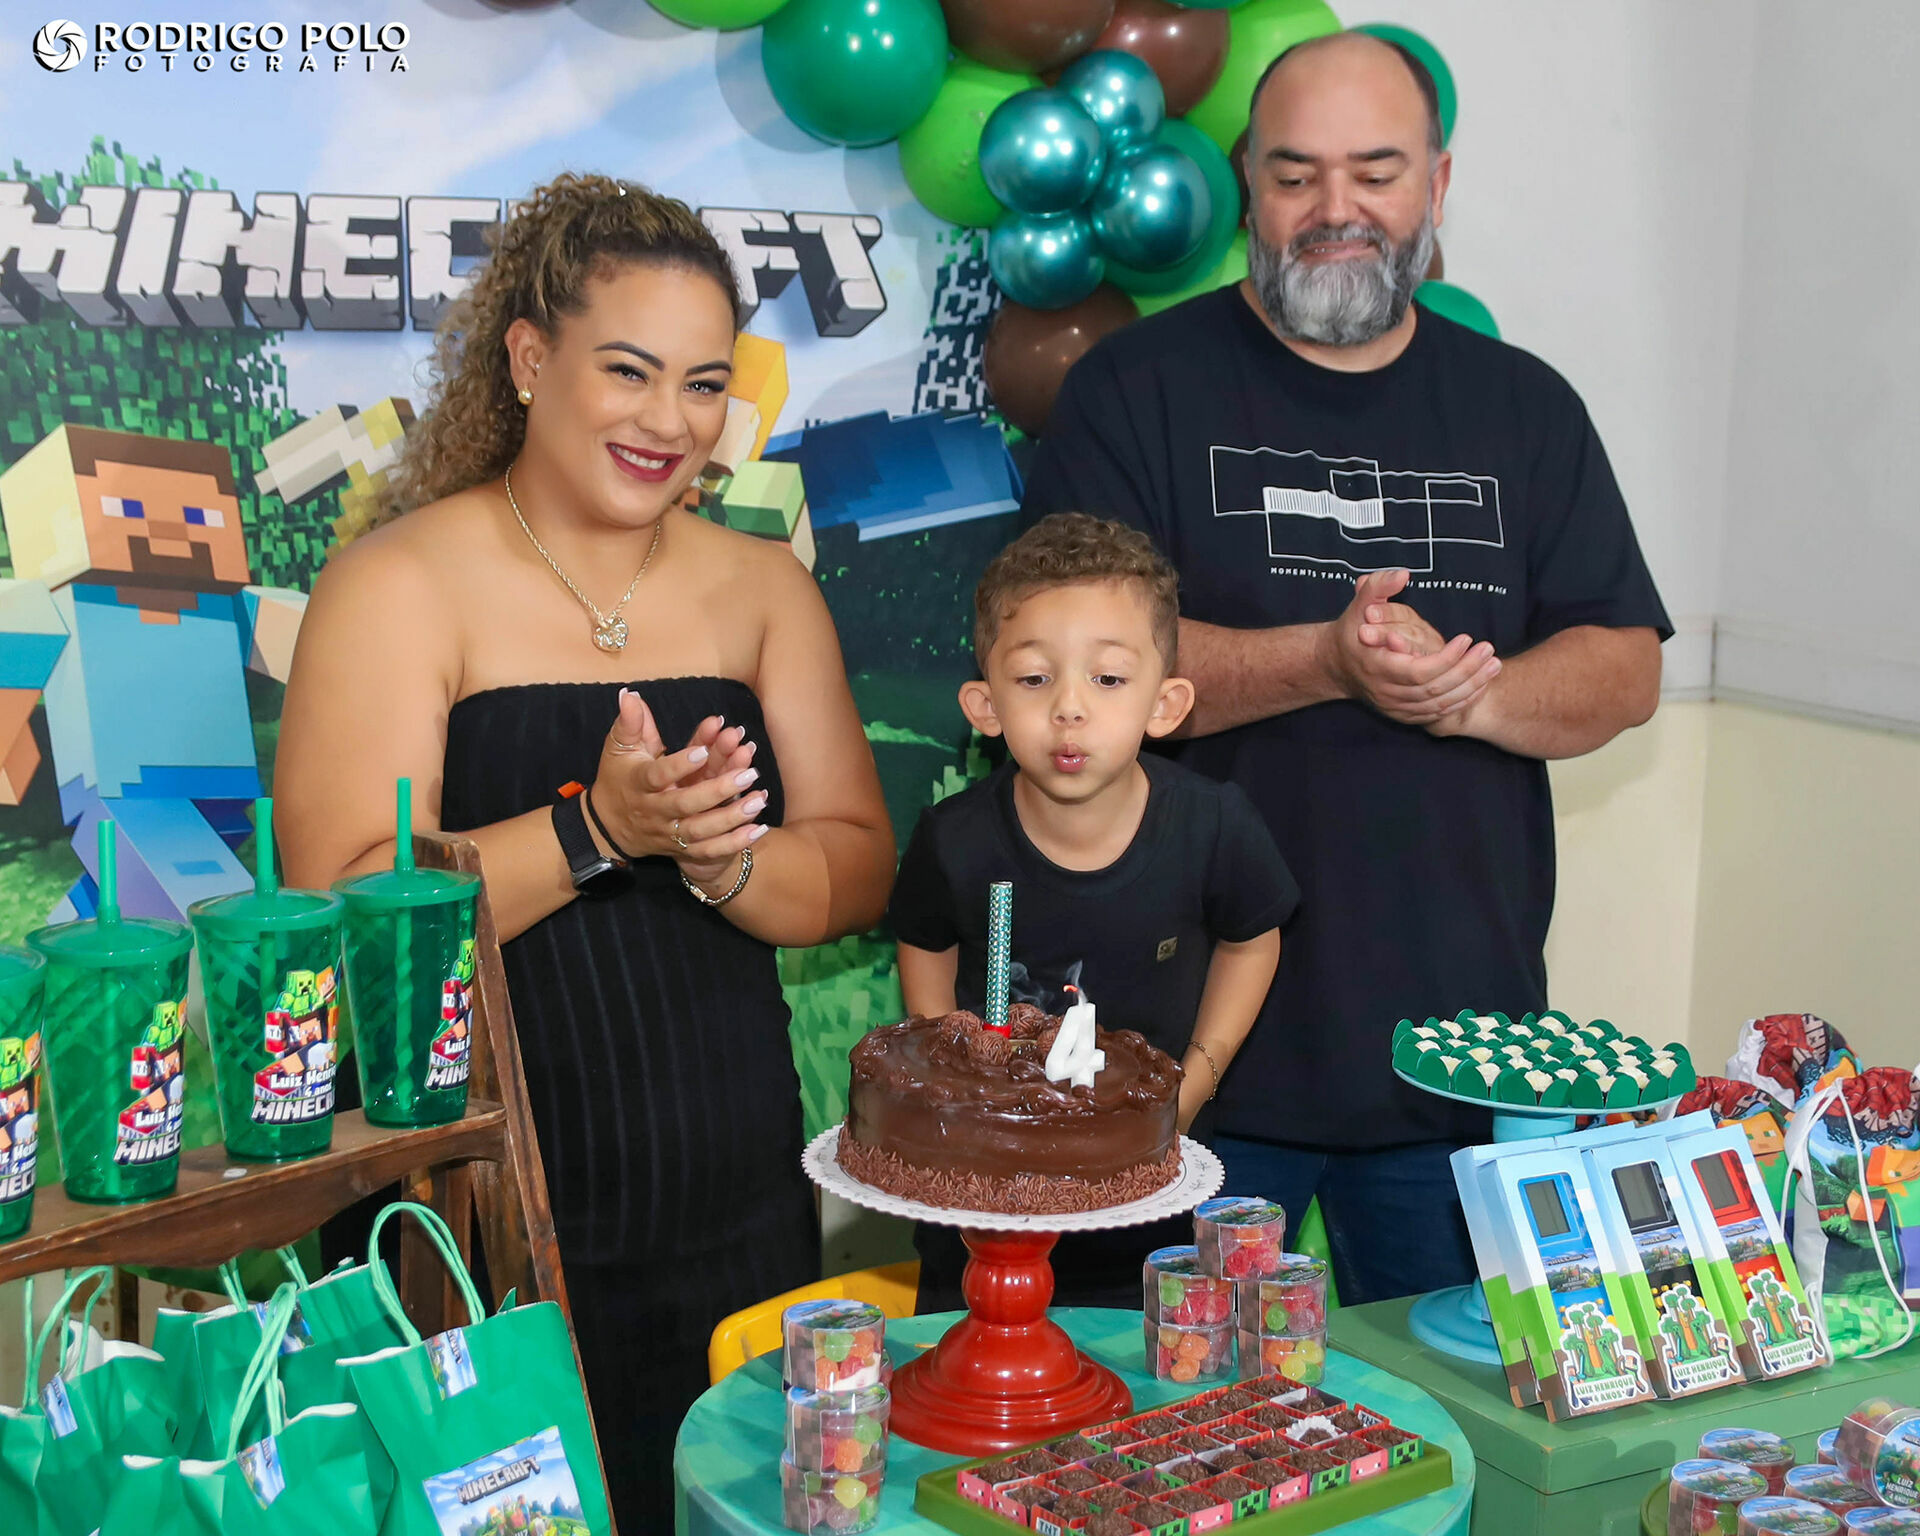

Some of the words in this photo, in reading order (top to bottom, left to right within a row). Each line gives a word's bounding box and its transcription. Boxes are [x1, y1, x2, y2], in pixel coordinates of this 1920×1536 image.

[0, 182, 887, 337] MINECFT
[1045, 1002, 1105, 1089] 4
[271, 1072, 303, 1089] Luiz
[135, 1109, 166, 1127] Luiz
[1675, 1366, 1691, 1378] LUIZ
[1691, 1358, 1727, 1374] HENRIQUE
[1575, 1385, 1593, 1395] LUIZ
[1594, 1378, 1634, 1392] HENRIQUE
[456, 1455, 541, 1505] MINECRAFT
[1897, 1477, 1914, 1489] LUIZ
